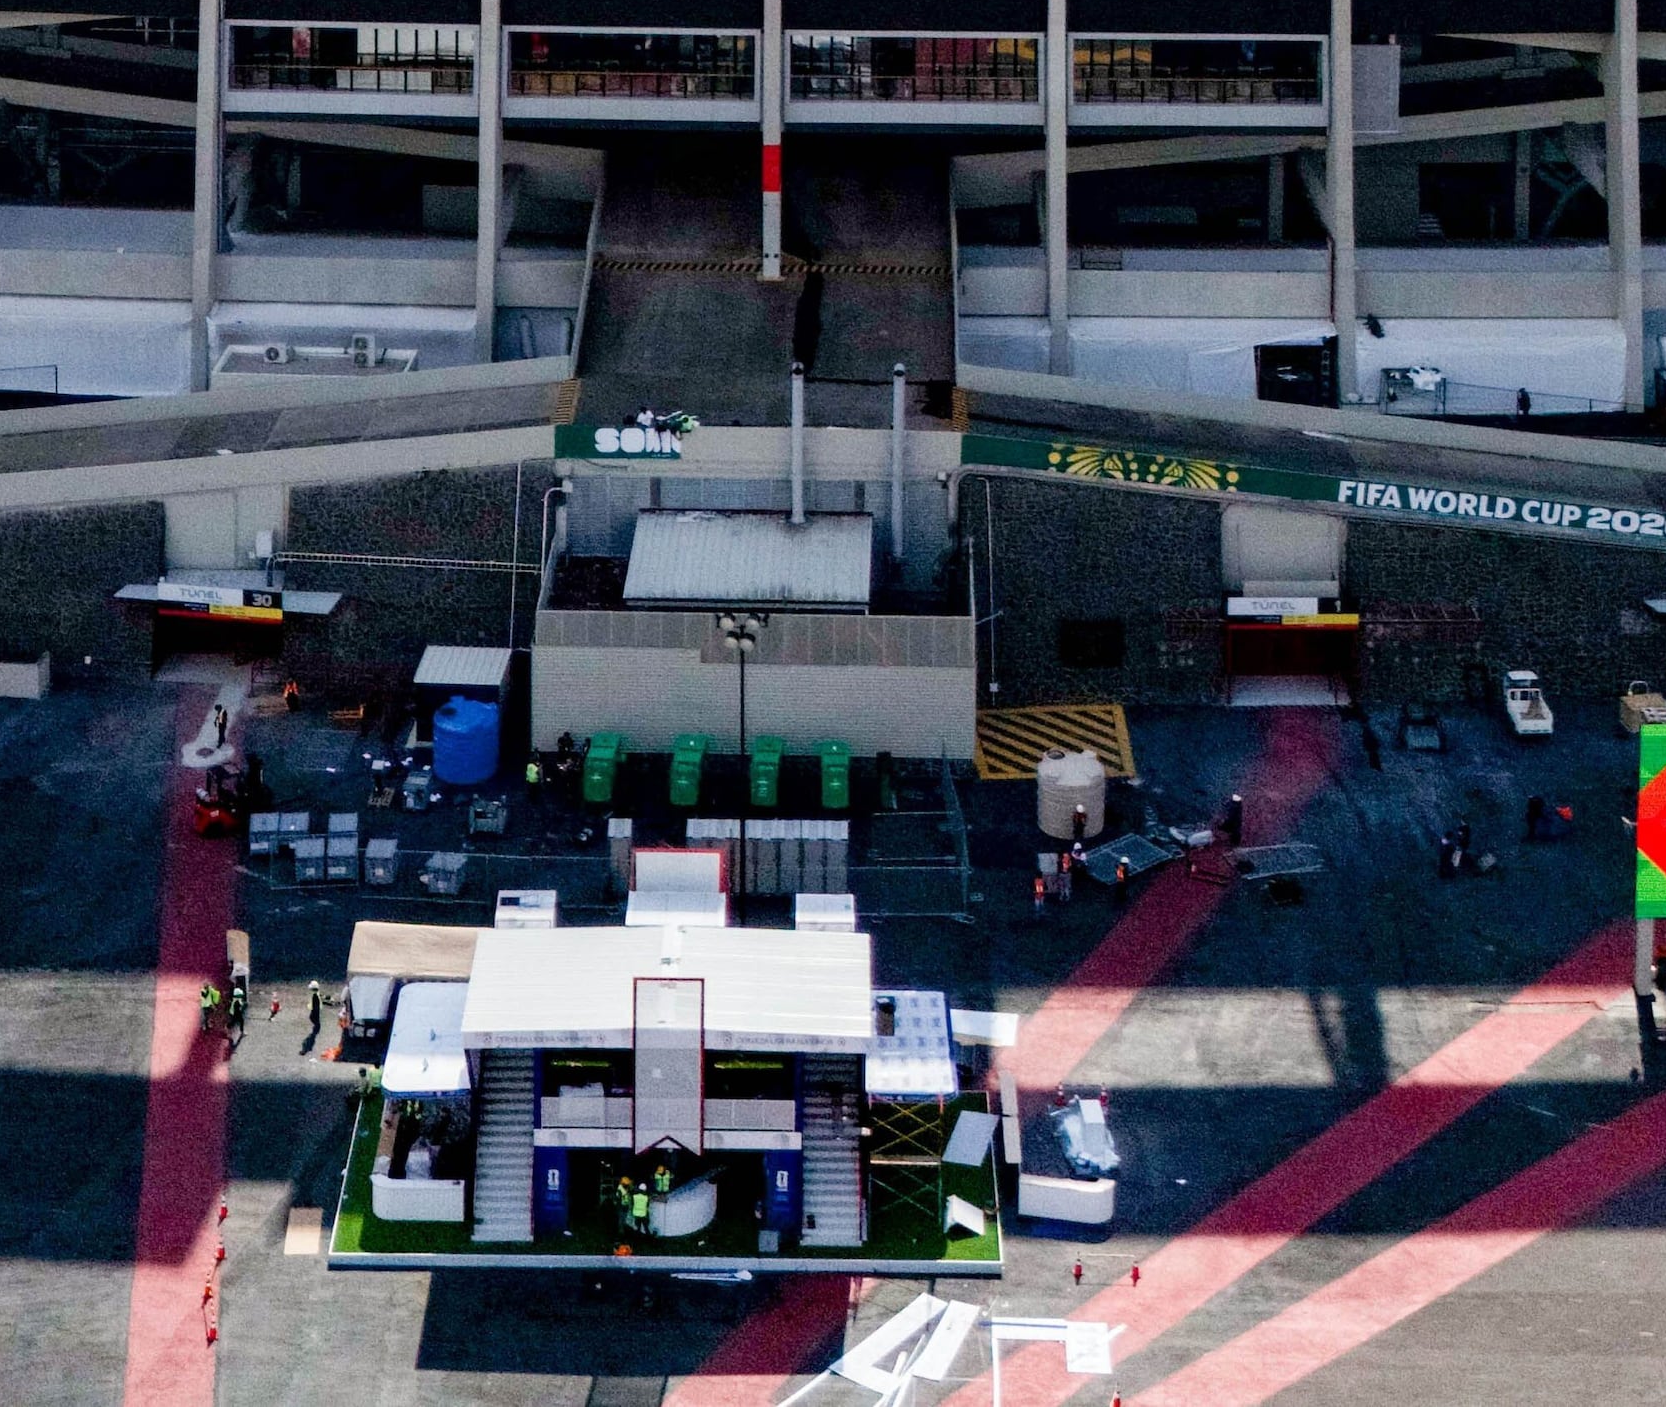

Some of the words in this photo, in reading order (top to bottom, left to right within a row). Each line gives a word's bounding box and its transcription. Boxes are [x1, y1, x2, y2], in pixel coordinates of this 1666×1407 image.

[1337, 480, 1402, 509] FIFA
[1407, 486, 1517, 520] WORLD
[1521, 499, 1582, 527] CUP
[251, 593, 273, 607] 30
[1334, 599, 1342, 613] 1
